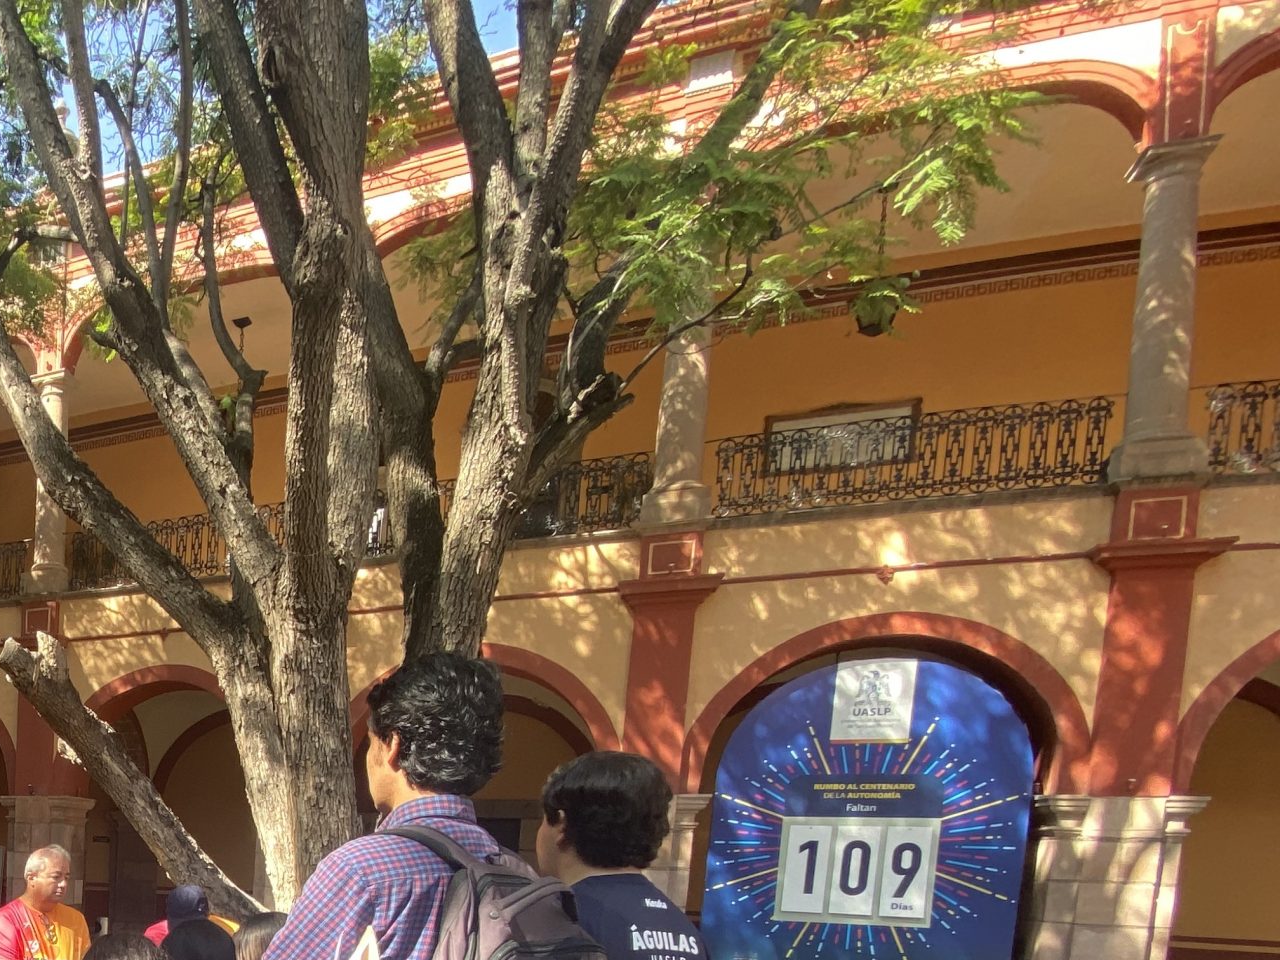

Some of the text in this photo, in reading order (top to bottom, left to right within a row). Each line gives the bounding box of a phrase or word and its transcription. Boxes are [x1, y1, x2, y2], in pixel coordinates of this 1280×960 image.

[852, 707, 891, 717] UASLP
[846, 791, 901, 799] AUTONOMÍA
[846, 803, 877, 812] Faltan
[798, 839, 922, 898] 109
[890, 902, 914, 911] Días
[630, 924, 699, 955] ÁGUILAS
